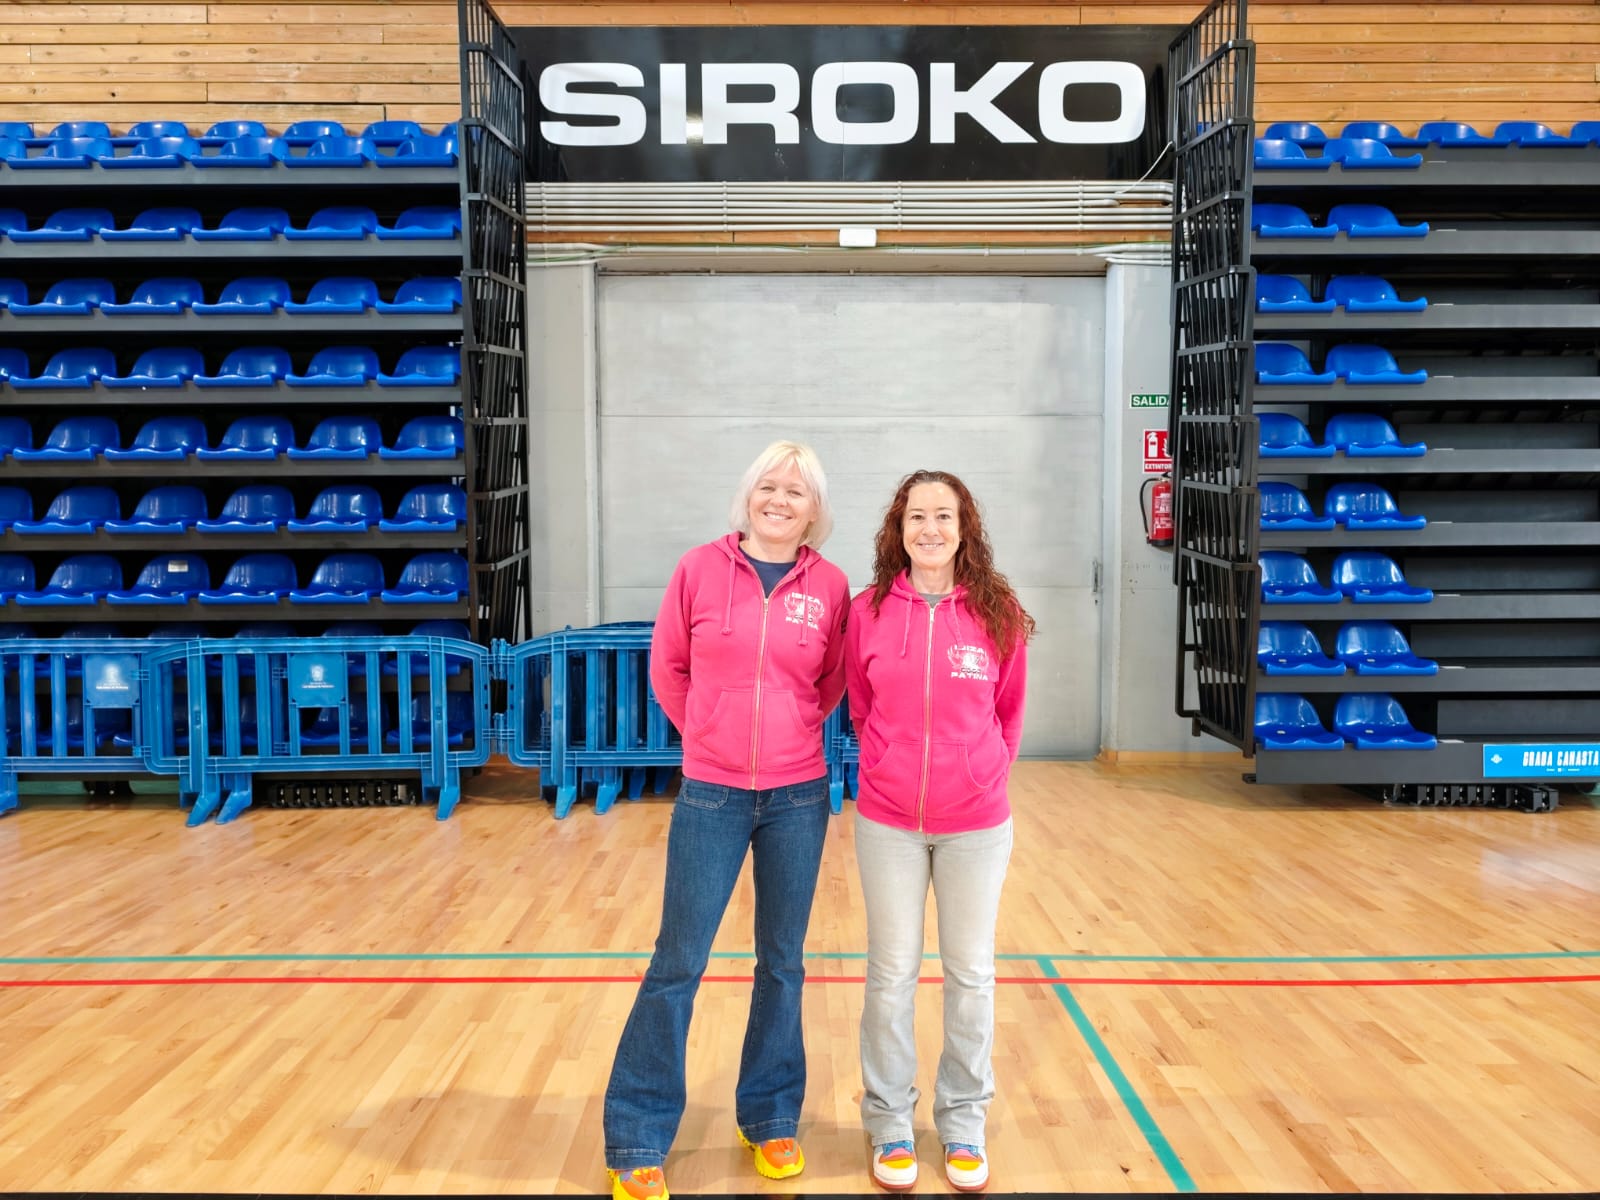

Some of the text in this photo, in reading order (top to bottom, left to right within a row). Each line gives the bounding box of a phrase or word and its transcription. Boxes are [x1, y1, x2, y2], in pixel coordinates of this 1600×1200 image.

[539, 61, 1147, 146] SIROKO
[1133, 396, 1169, 406] SALID
[786, 616, 818, 631] PATNA
[1523, 751, 1599, 767] GRADA CANASTA
